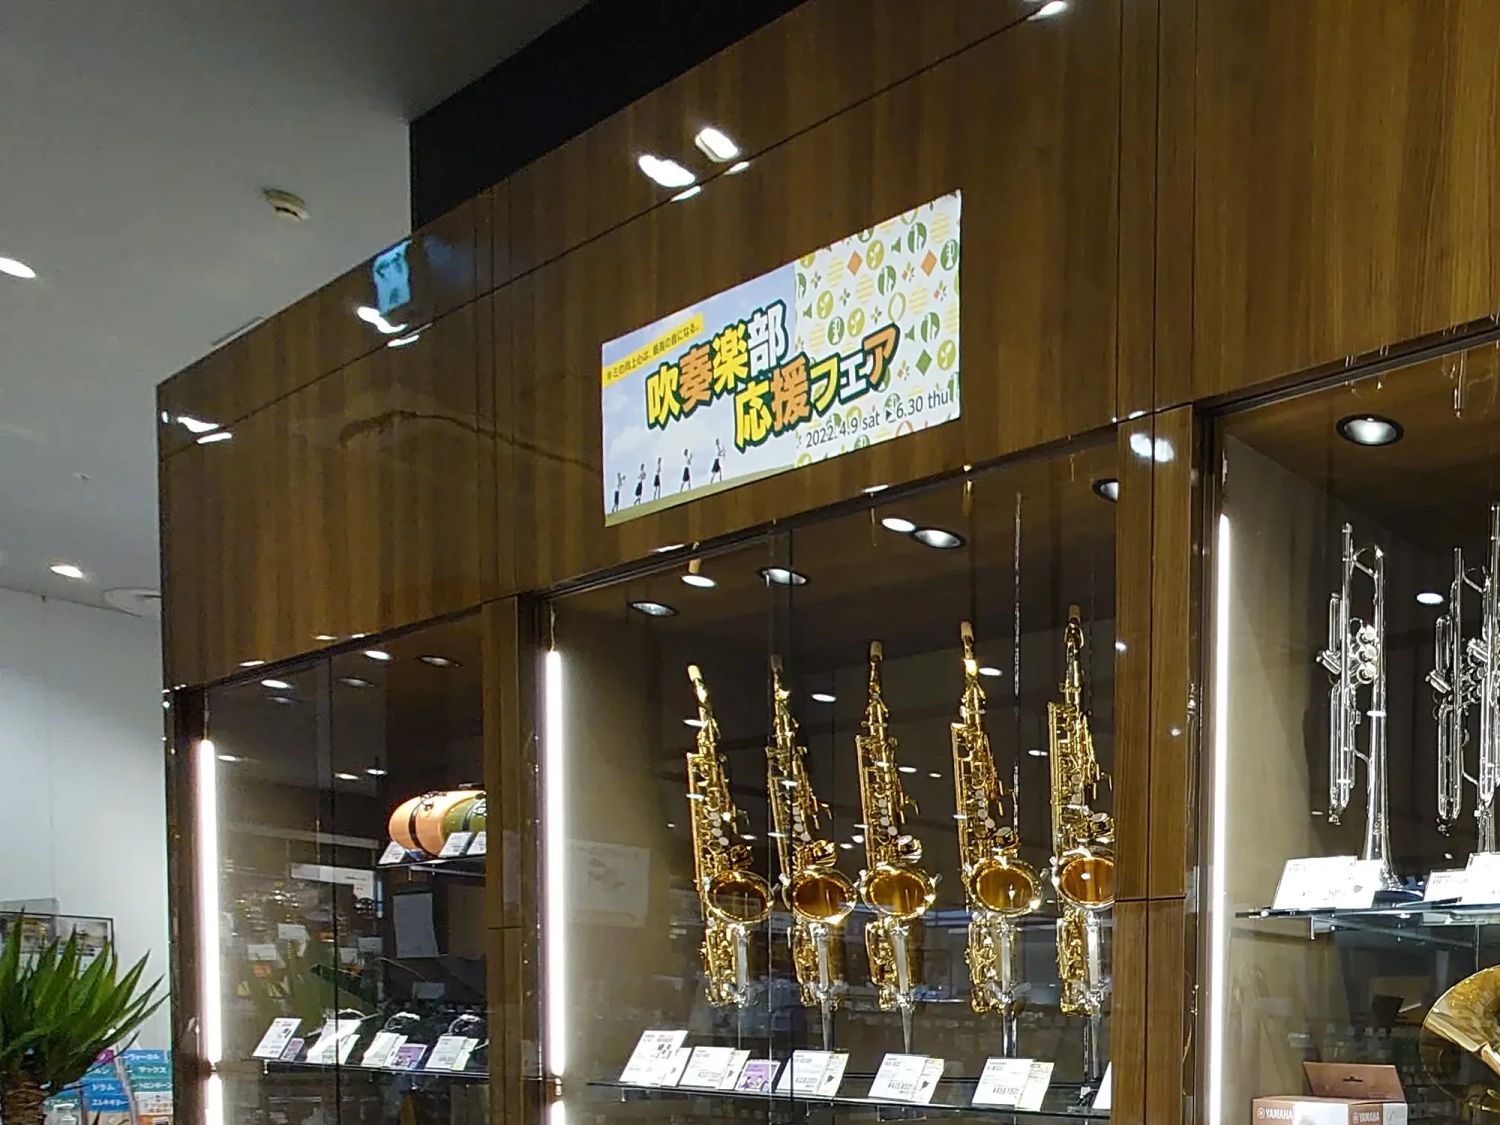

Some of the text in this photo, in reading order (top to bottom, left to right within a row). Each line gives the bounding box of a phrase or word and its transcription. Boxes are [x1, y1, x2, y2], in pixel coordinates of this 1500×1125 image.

[645, 300, 790, 430] 吹奏楽部
[732, 322, 900, 455] 応援フェア
[805, 389, 949, 449] 2022.4.9 sat 6.30 thu
[1265, 1107, 1295, 1120] YAMAHA
[1358, 1111, 1380, 1123] YAMAHA
